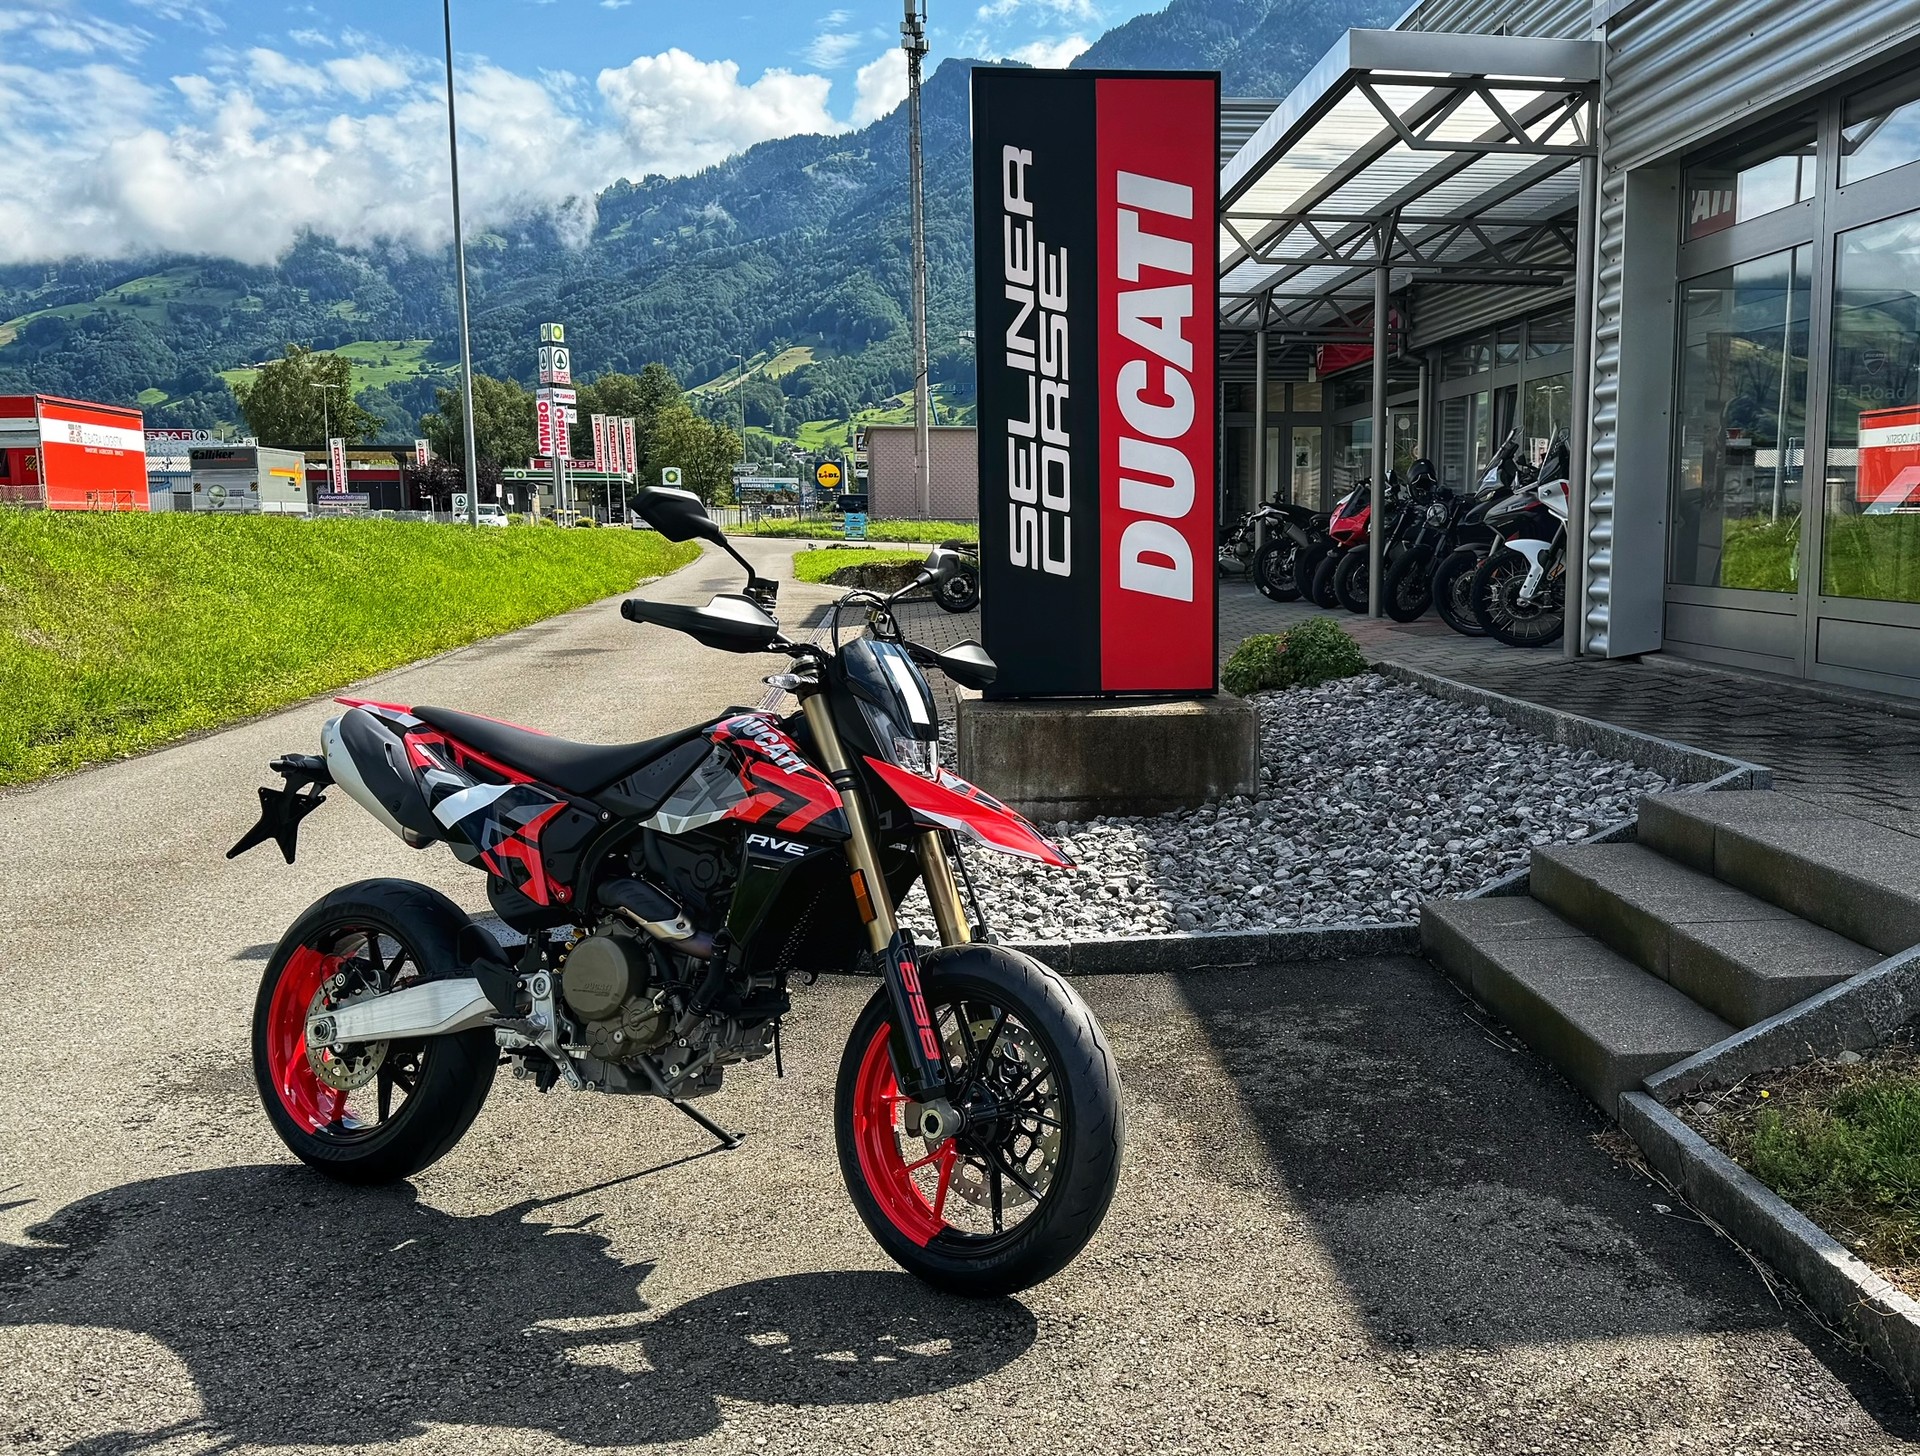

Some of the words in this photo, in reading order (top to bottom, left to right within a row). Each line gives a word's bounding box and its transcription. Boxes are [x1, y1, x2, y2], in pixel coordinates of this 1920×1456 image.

[1002, 143, 1038, 571] SELINER
[1115, 169, 1197, 603] DUCATI
[191, 449, 235, 460] Galliker
[1037, 241, 1072, 578] CORSE
[733, 716, 808, 775] DUCATI
[746, 833, 810, 857] RVE
[899, 961, 941, 1060] 698
